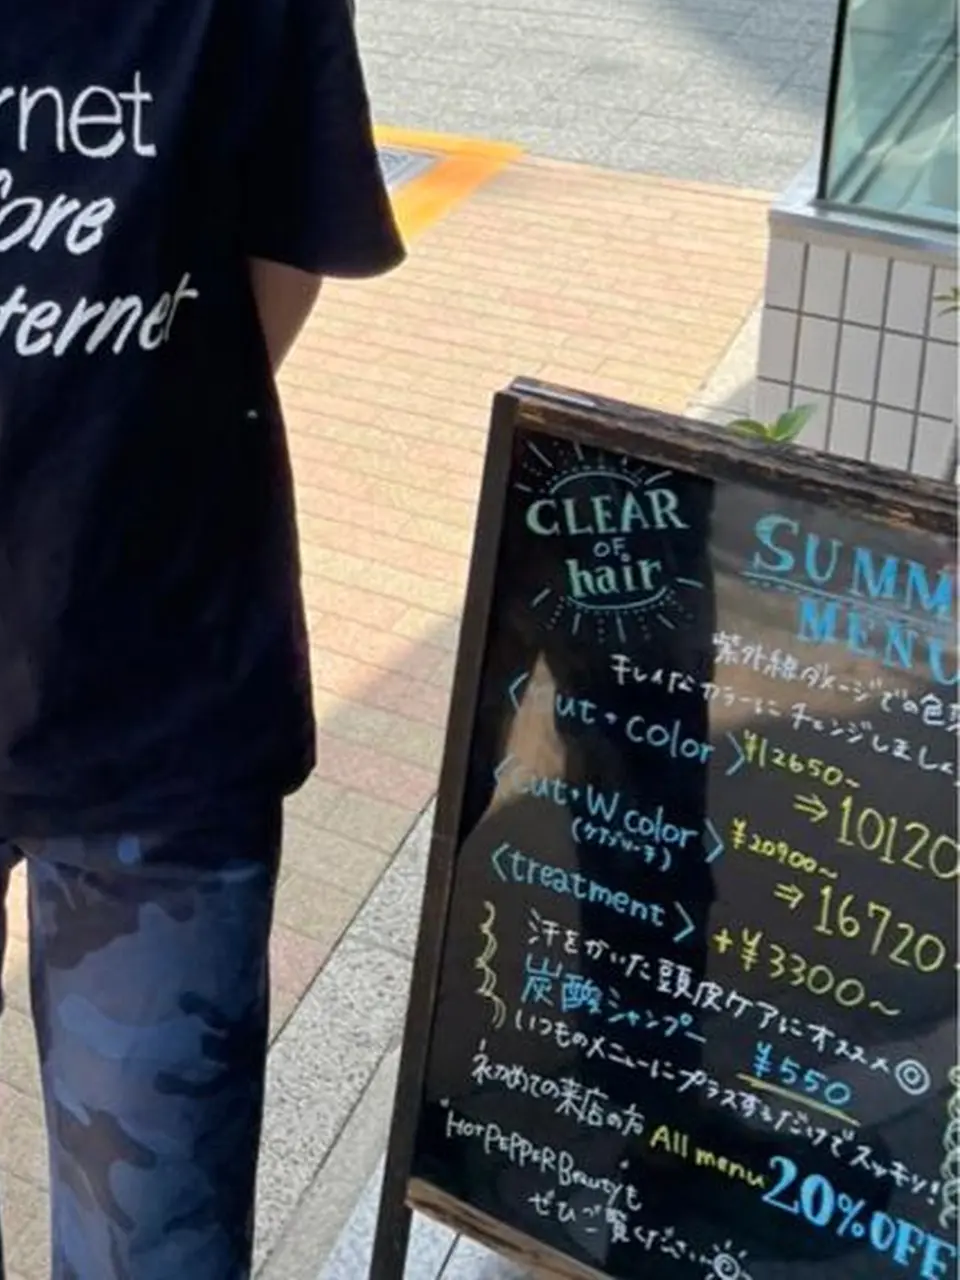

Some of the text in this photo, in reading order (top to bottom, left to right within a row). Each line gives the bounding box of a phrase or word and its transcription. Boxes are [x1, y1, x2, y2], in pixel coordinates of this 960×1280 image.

[526, 488, 691, 536] CLEAR
[565, 552, 663, 599] hair
[753, 514, 953, 623] SUMM
[837, 795, 960, 878] 10120
[814, 885, 947, 972] 16720
[754, 1040, 852, 1105] ¥550
[650, 1124, 689, 1159] All
[694, 1147, 768, 1190] menu
